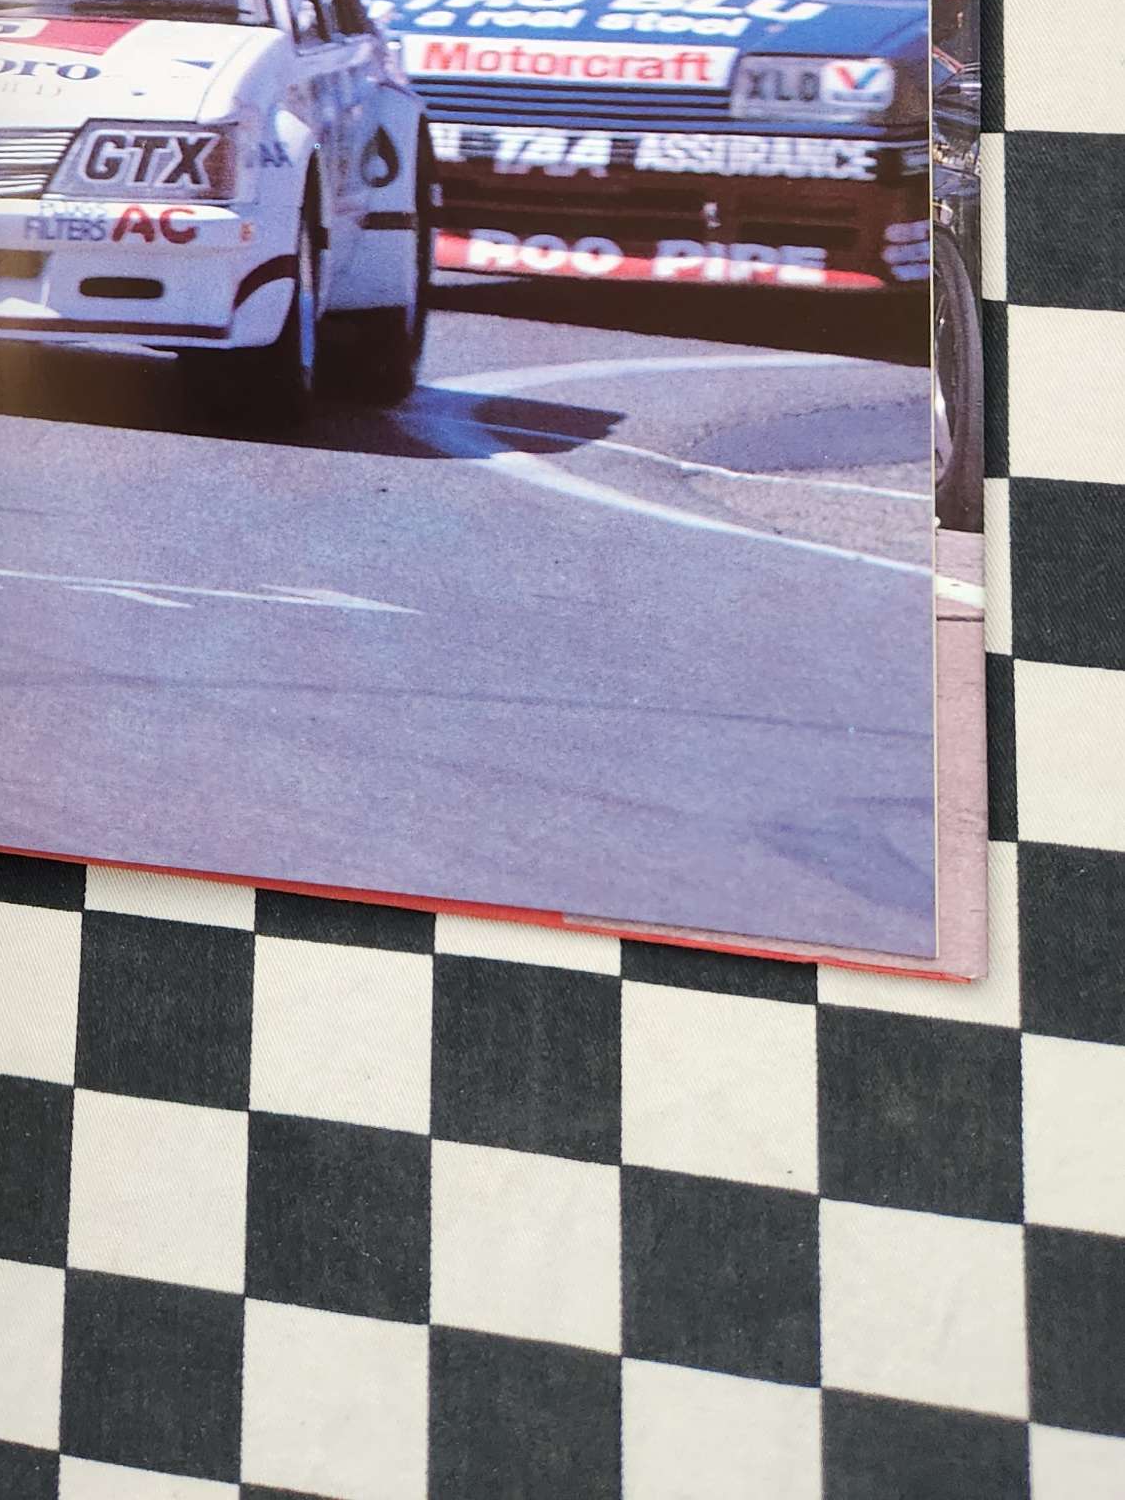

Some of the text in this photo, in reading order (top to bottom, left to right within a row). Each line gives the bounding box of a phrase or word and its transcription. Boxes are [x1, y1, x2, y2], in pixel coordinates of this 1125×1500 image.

[420, 41, 712, 84] Motorcraft
[81, 129, 218, 185] GTX
[111, 203, 200, 245] AC
[468, 228, 828, 284] ROO PIPE
